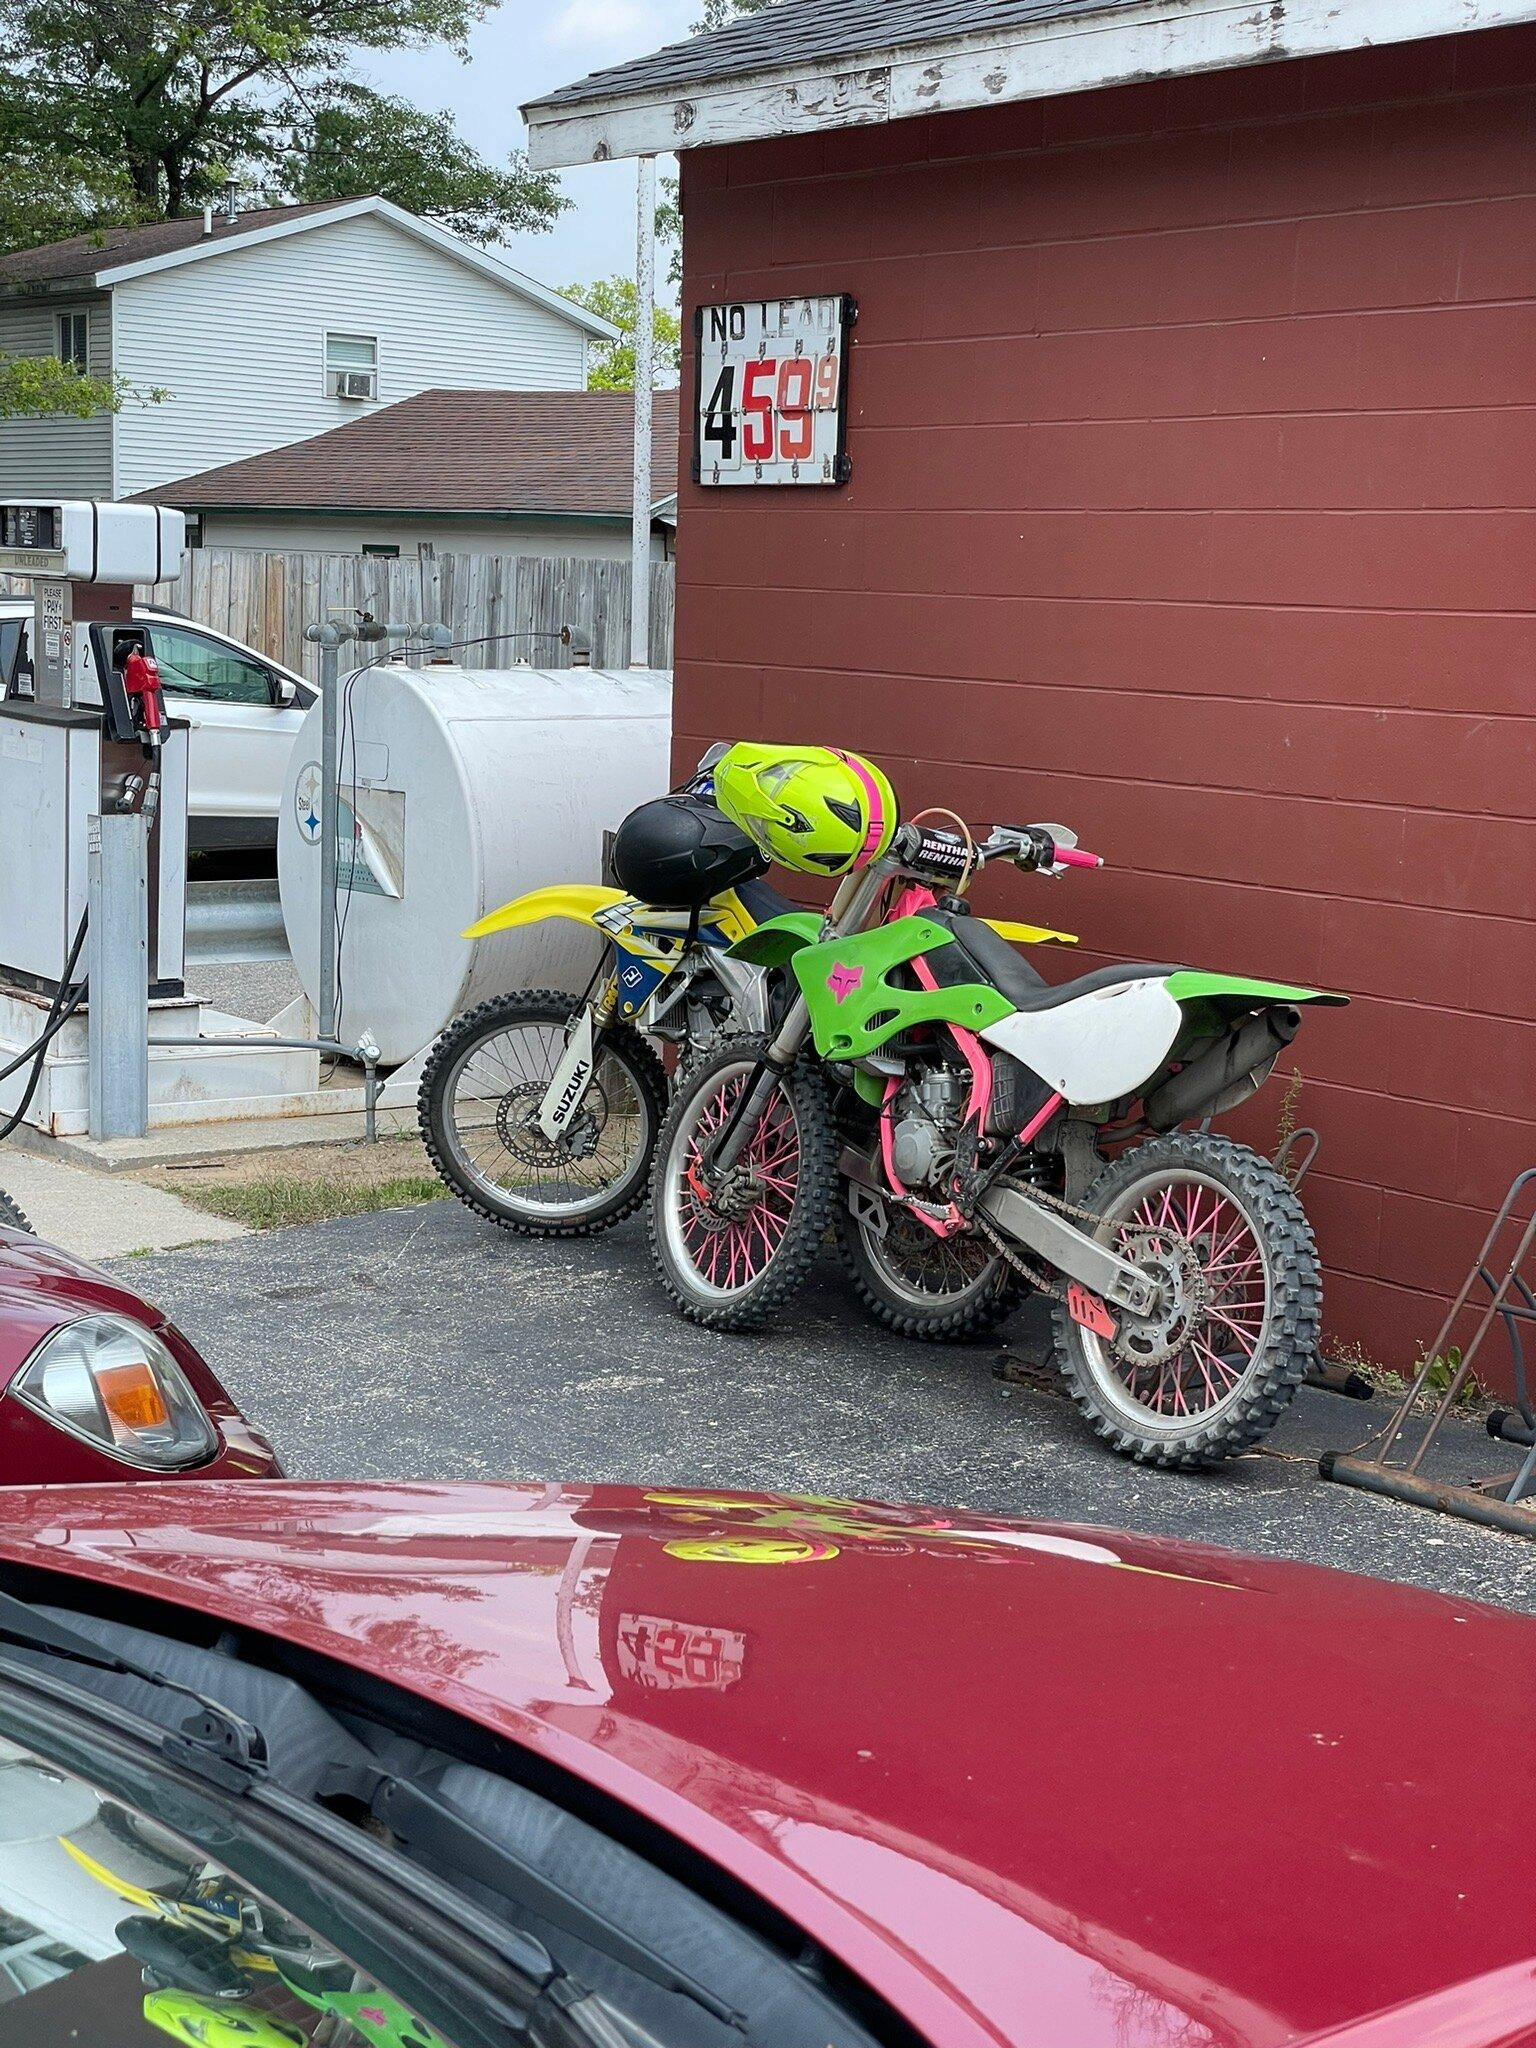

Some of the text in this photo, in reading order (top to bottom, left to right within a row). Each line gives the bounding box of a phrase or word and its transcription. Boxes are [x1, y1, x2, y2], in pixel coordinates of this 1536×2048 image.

[710, 305, 746, 342] NO
[14, 554, 49, 568] UNLEADED
[43, 587, 62, 598] PLEASE
[43, 615, 62, 630] FIRST
[83, 644, 90, 669] 2
[553, 1059, 590, 1124] SUZUKI
